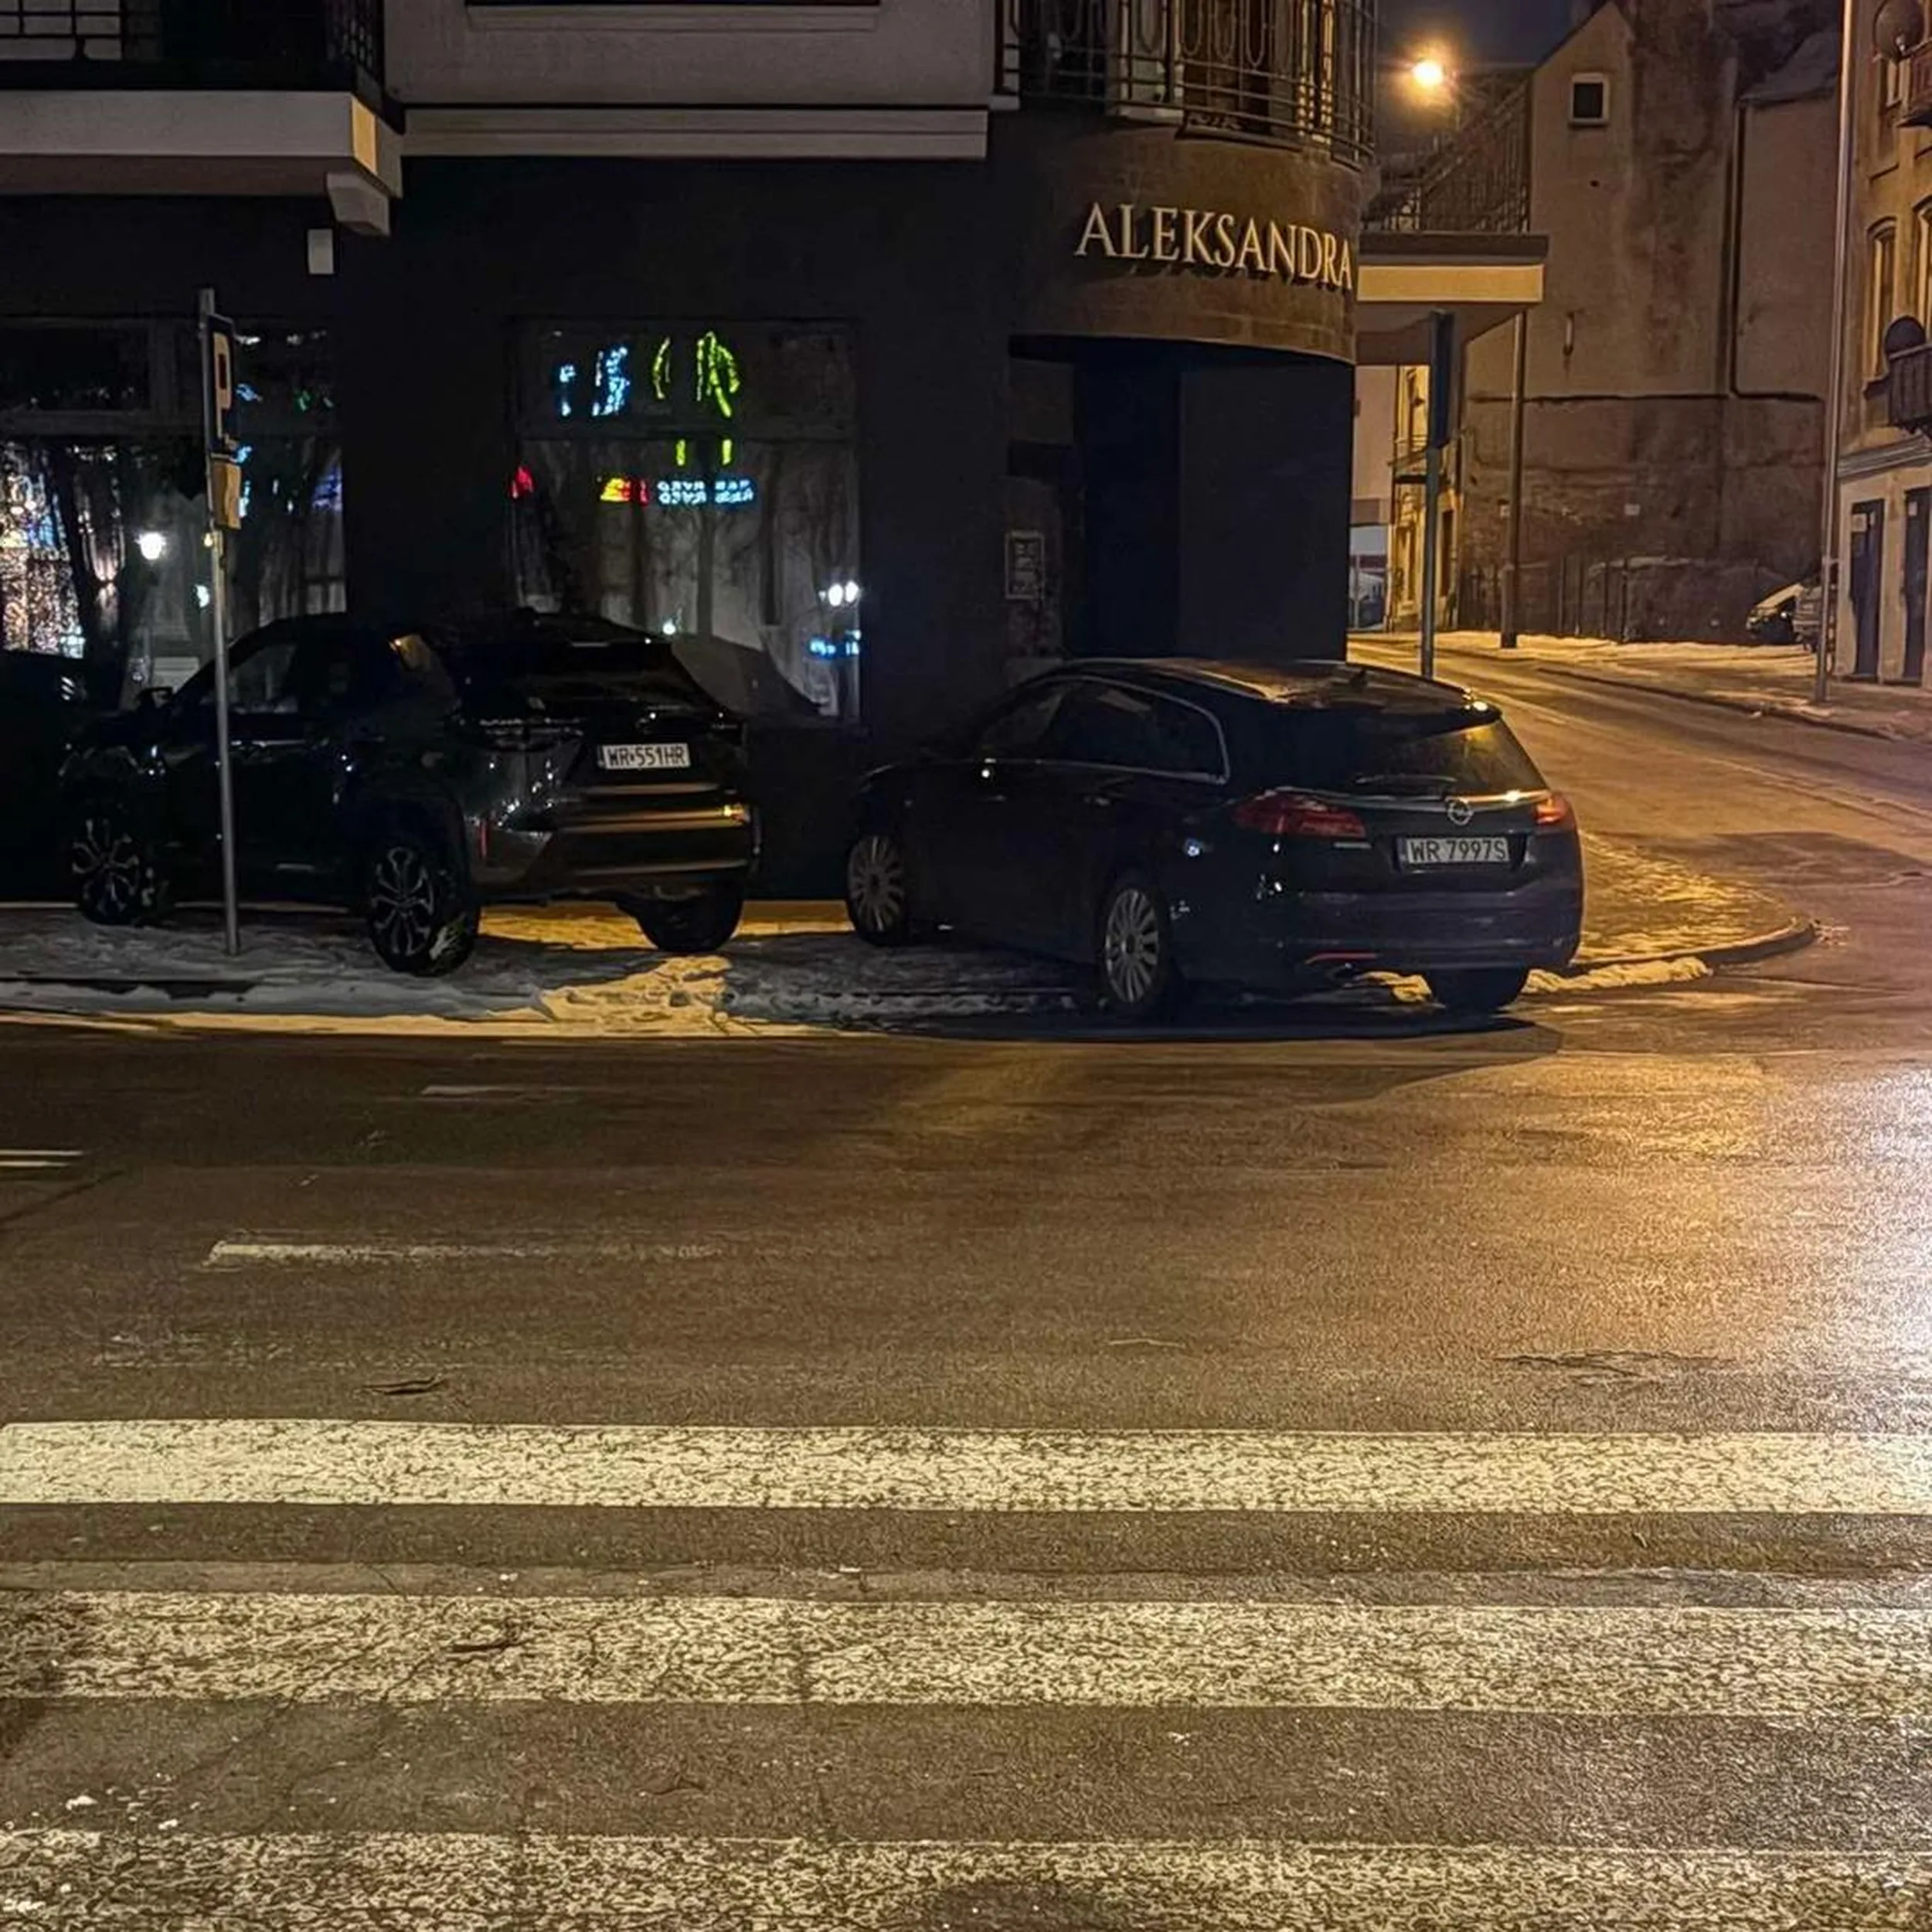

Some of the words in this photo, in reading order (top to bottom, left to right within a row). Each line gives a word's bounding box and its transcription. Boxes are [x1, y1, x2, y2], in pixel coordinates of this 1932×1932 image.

[1073, 202, 1352, 291] ALEKSANDRA
[1410, 841, 1440, 861] WR
[1446, 839, 1506, 860] 7997S
